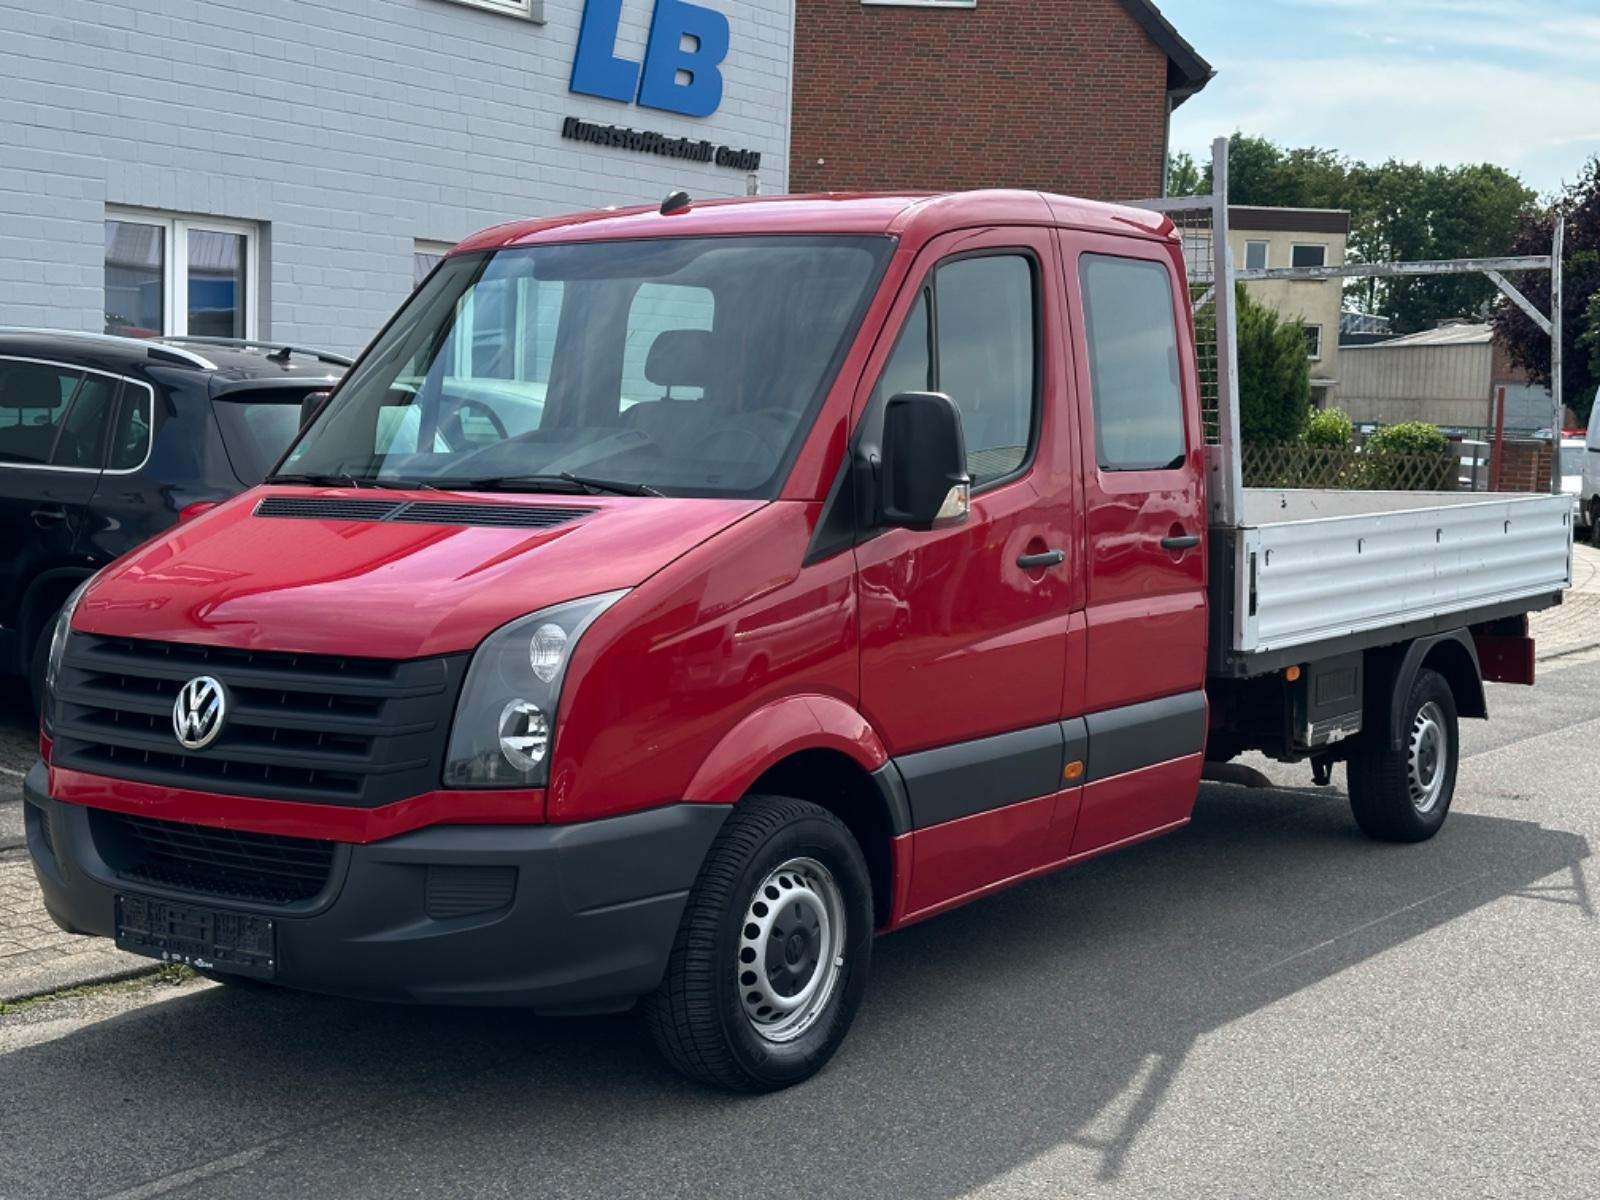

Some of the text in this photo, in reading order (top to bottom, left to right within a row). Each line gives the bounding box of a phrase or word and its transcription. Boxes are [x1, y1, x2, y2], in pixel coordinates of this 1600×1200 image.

[569, 0, 730, 117] LB
[561, 116, 761, 171] Kunststofftechnik GmbH
[173, 676, 225, 749] VW
